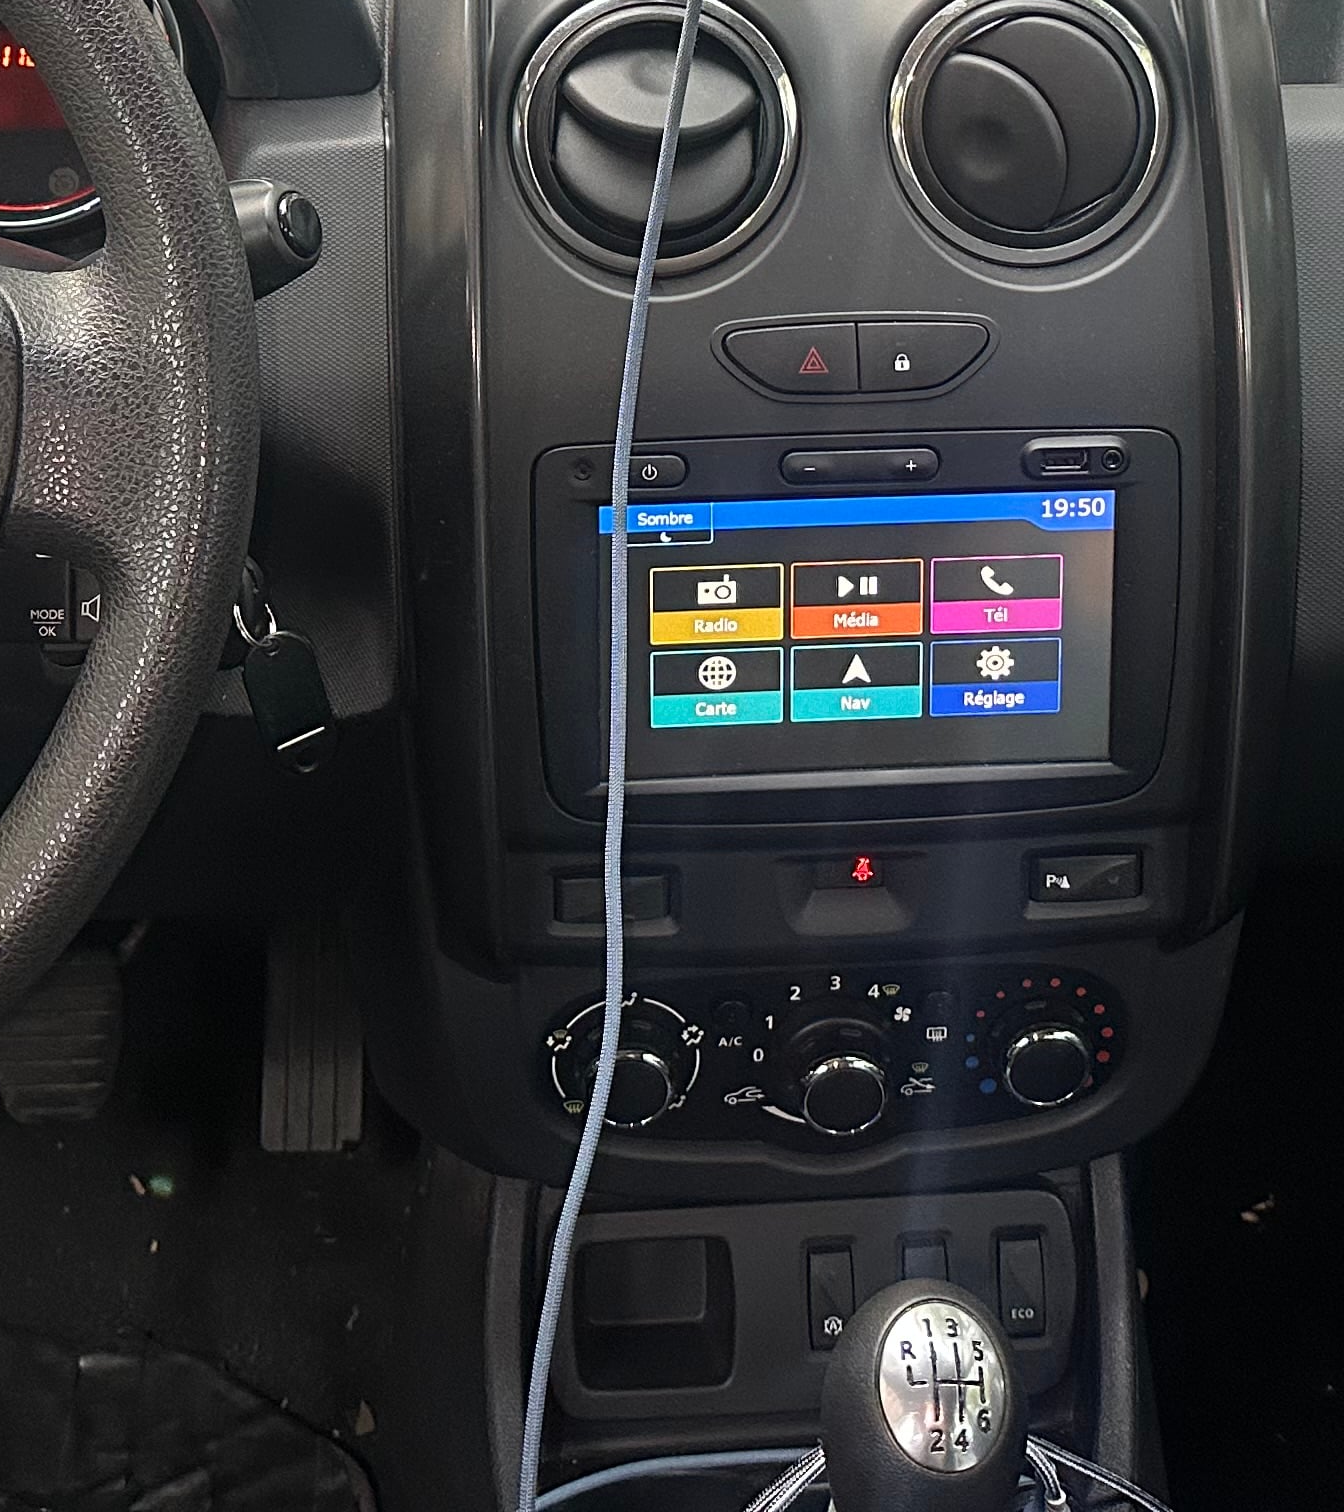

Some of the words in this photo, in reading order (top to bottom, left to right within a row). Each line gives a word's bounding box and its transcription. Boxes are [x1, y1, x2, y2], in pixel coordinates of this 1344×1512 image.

[1040, 496, 1106, 519] 19:50
[637, 510, 694, 526] Sombre
[30, 609, 65, 621] MODE
[833, 611, 879, 628] Média
[983, 606, 1009, 623] Tél
[38, 625, 57, 637] OK
[693, 617, 738, 633] Radio
[840, 696, 871, 711] Nav
[963, 689, 1025, 708] Réglage
[695, 700, 737, 716] Carte
[830, 975, 841, 990] 3
[790, 986, 801, 1001] 2
[867, 984, 880, 998] 4
[765, 1015, 773, 1030] 1
[718, 1036, 743, 1047] A/C
[753, 1048, 764, 1062] 0
[1011, 1307, 1034, 1319] ECO
[922, 1318, 934, 1337] 1
[945, 1318, 958, 1338] 3
[900, 1341, 917, 1361] R
[972, 1341, 984, 1362] 5
[977, 1409, 992, 1434] 6
[930, 1430, 945, 1453] 2
[954, 1430, 970, 1453] 4
